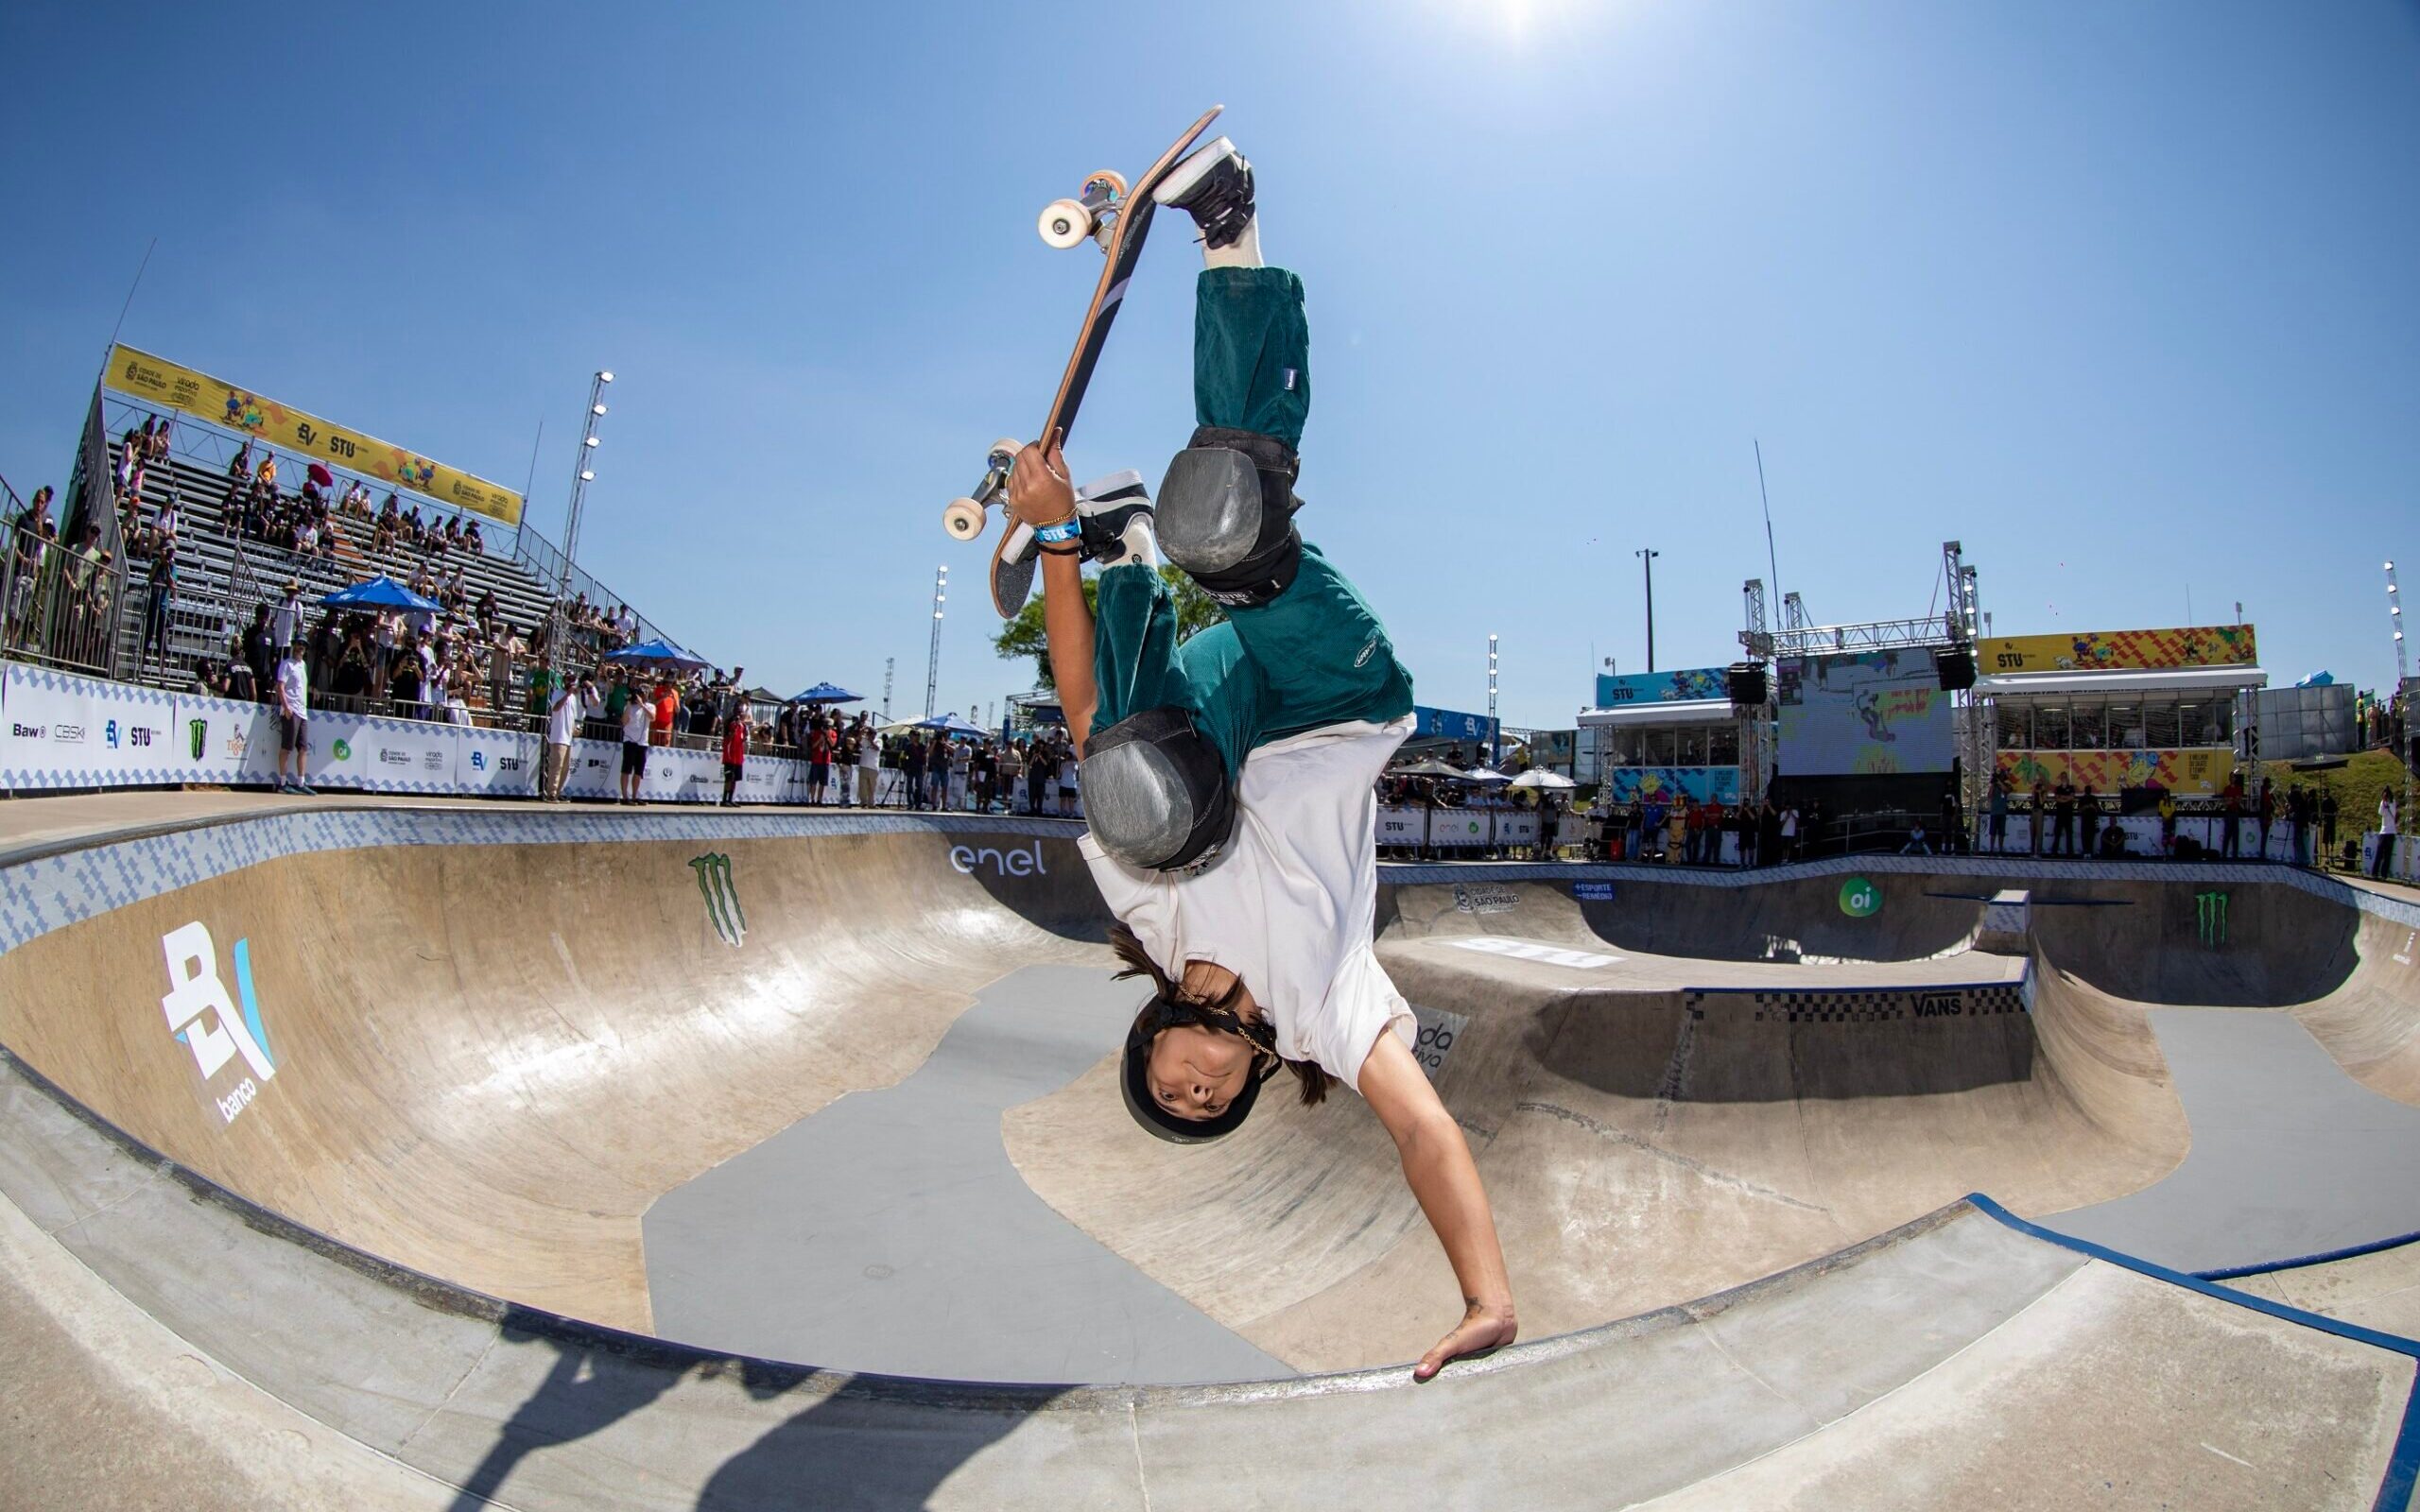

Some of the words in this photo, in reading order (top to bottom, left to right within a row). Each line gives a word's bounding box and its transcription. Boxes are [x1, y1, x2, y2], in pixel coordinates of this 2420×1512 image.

[330, 436, 355, 458] STU
[1042, 527, 1068, 541] STU
[1996, 652, 2023, 668] STU
[1612, 687, 1634, 701] STU
[12, 723, 39, 738] Baw
[130, 727, 151, 747] STU
[499, 757, 519, 771] STU
[1385, 820, 1405, 832] STU
[950, 839, 1046, 876] enel
[1494, 893, 1520, 904] PAULO
[1850, 885, 1872, 909] oi
[216, 1077, 257, 1124] banco
